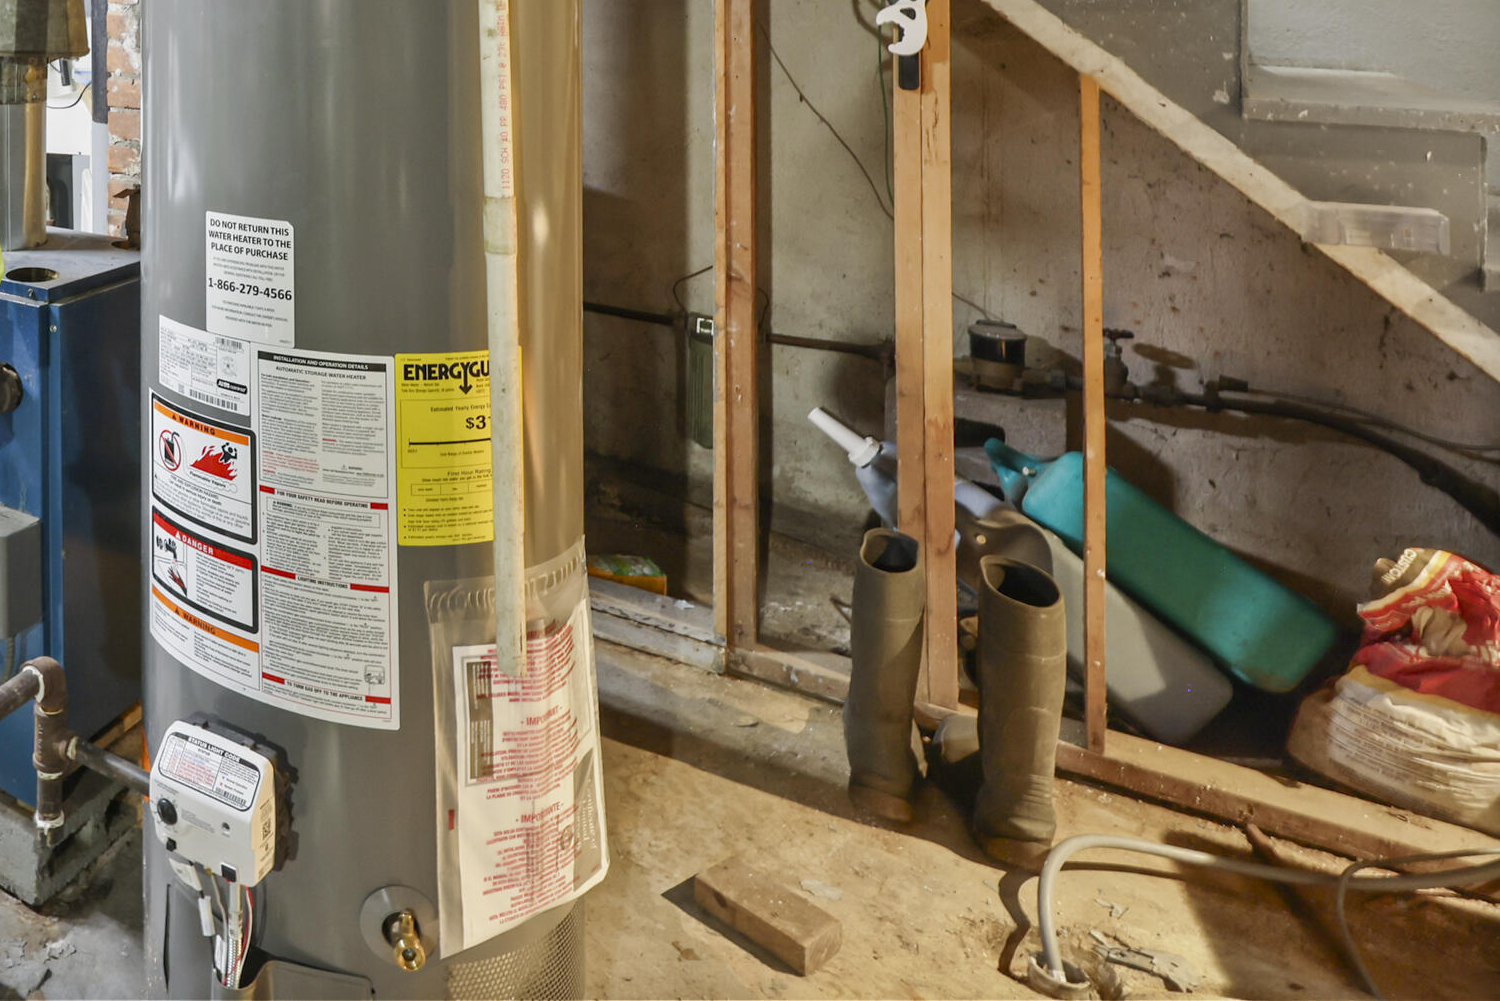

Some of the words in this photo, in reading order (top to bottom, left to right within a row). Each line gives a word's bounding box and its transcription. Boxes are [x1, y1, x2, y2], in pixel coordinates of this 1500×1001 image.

[210, 219, 221, 227] DO
[222, 221, 237, 230] NOT
[238, 223, 269, 234] RETURN
[270, 227, 289, 236] THIS
[209, 230, 232, 241] WATER
[233, 234, 262, 245] HEATER
[263, 239, 274, 247] TO
[275, 240, 291, 249] THE
[211, 242, 232, 253] PLACE
[234, 245, 244, 254] OF
[245, 248, 288, 260] PURCHASE
[208, 278, 292, 301] 1-866-279-4566
[273, 355, 306, 364] INSTALLATION
[319, 360, 347, 369] OPERATION
[276, 366, 303, 374] AUTOMATIC
[404, 360, 489, 385] ENERGYGU
[180, 416, 216, 435] WARNING
[465, 415, 491, 429] $3
[182, 534, 214, 556] DANGER
[298, 576, 317, 584] LIGHTING
[317, 579, 348, 589] INSTRUCTIONS
[183, 613, 216, 635] WARNING
[339, 692, 363, 701] APPLIANCE
[189, 738, 207, 748] STATUS
[208, 744, 223, 755] LIGHT
[224, 751, 240, 762] CODE
